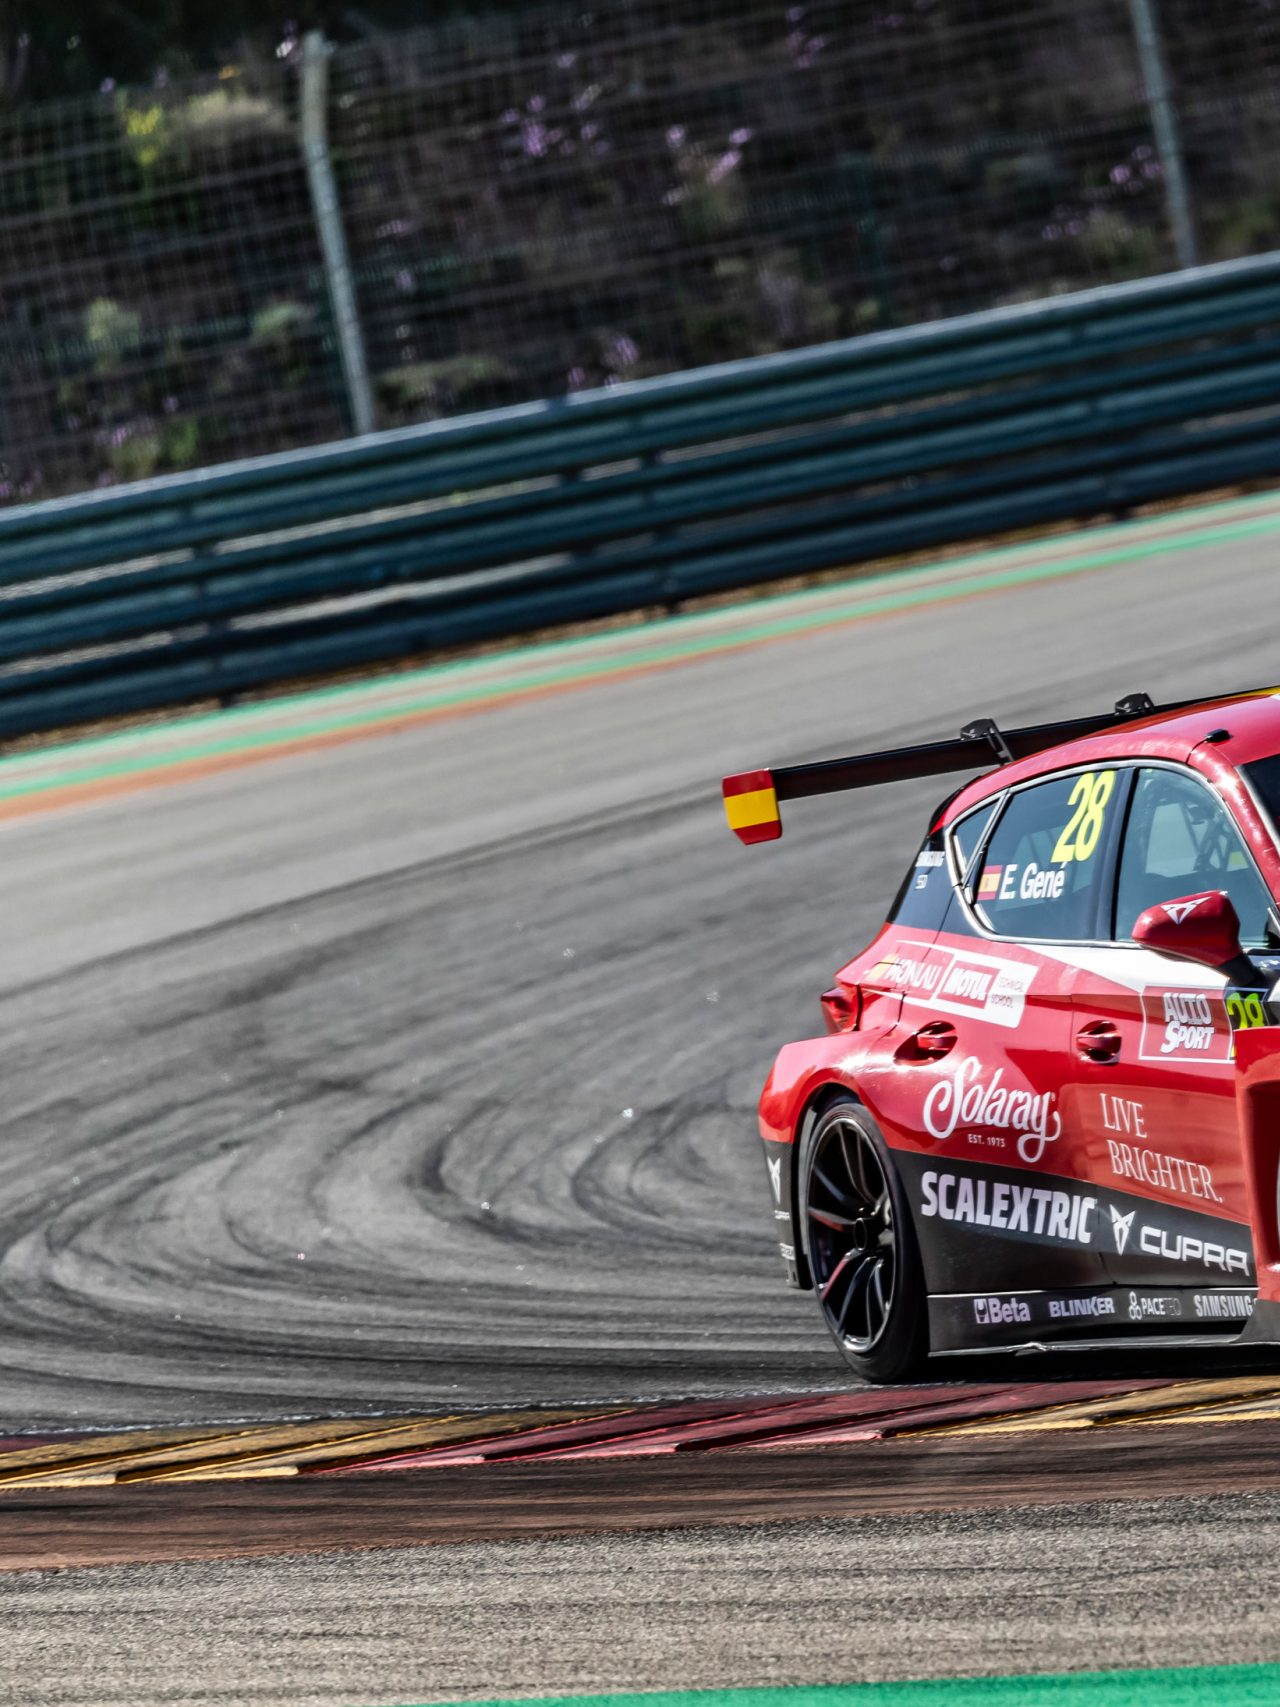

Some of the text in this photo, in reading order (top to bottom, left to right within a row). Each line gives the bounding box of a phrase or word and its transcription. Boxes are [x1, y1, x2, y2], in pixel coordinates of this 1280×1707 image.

[1051, 769, 1116, 863] 28
[1020, 861, 1067, 900] Gené
[943, 967, 993, 1001] MOTUL
[1163, 992, 1212, 1025] AUTO
[1160, 1021, 1215, 1054] SPORT
[923, 1056, 1061, 1163] Solaray
[1100, 1092, 1148, 1138] LIVE
[967, 1133, 985, 1145] EST.
[1106, 1139, 1224, 1204] BRIGHTER.
[920, 1170, 1098, 1244] SCALEXTRIC
[1140, 1225, 1250, 1277] CUPRA
[988, 1297, 1031, 1323] Beta
[1049, 1296, 1115, 1318] BLINKER
[1193, 1294, 1253, 1317] SAMSUNG
